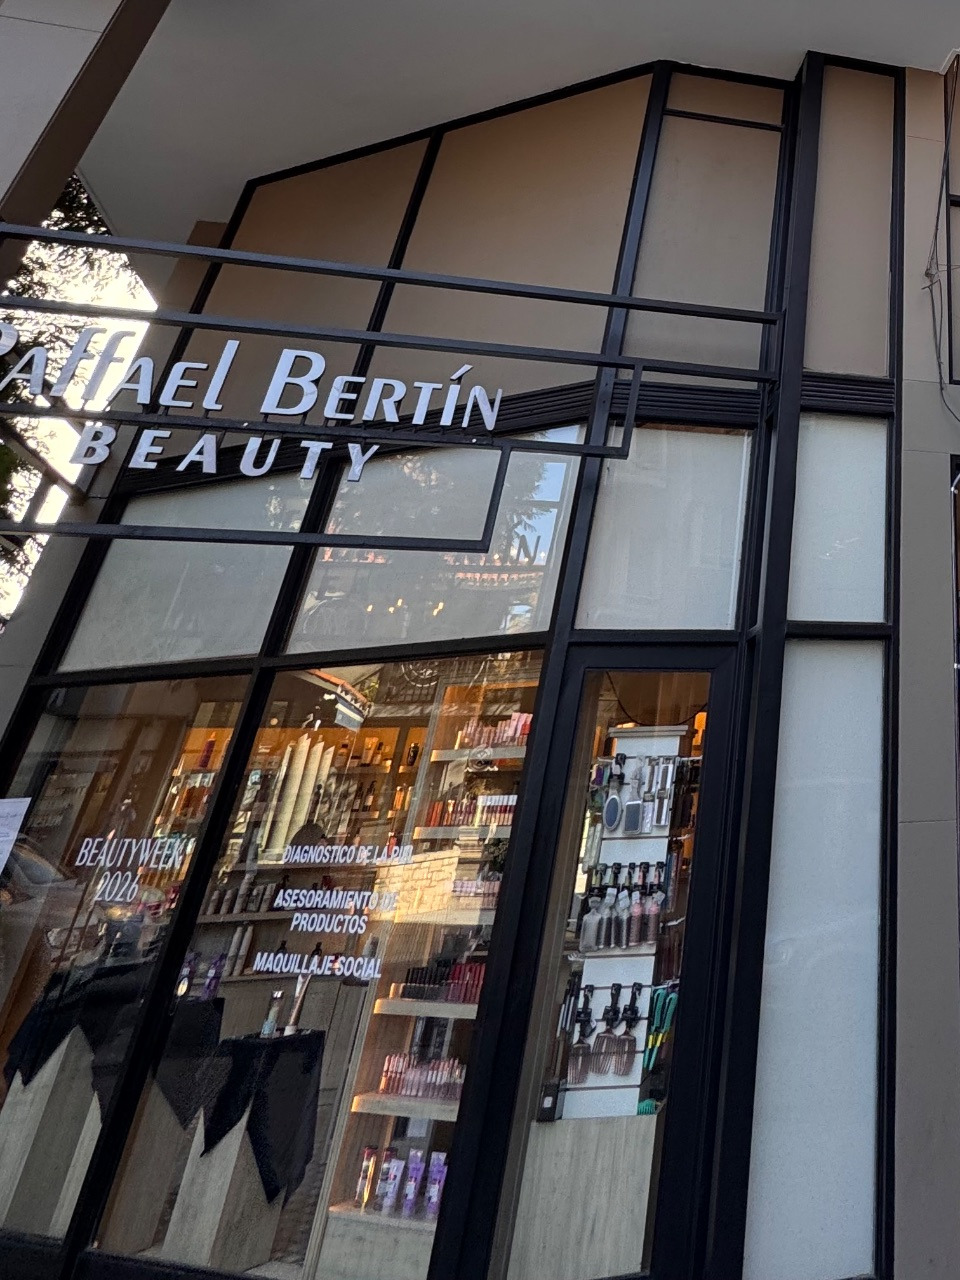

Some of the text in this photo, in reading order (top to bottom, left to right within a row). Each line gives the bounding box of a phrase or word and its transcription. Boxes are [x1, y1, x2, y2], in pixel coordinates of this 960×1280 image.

[69, 424, 379, 482] BEAUTY
[283, 844, 356, 864] DIAGNOSTICO
[356, 845, 373, 864] DE
[93, 870, 141, 903] 2026
[274, 888, 379, 910] ASESORAMIENTO
[290, 912, 369, 935] PRODUCTOS
[252, 951, 382, 979] MAQUILLAJE SOCIAL
